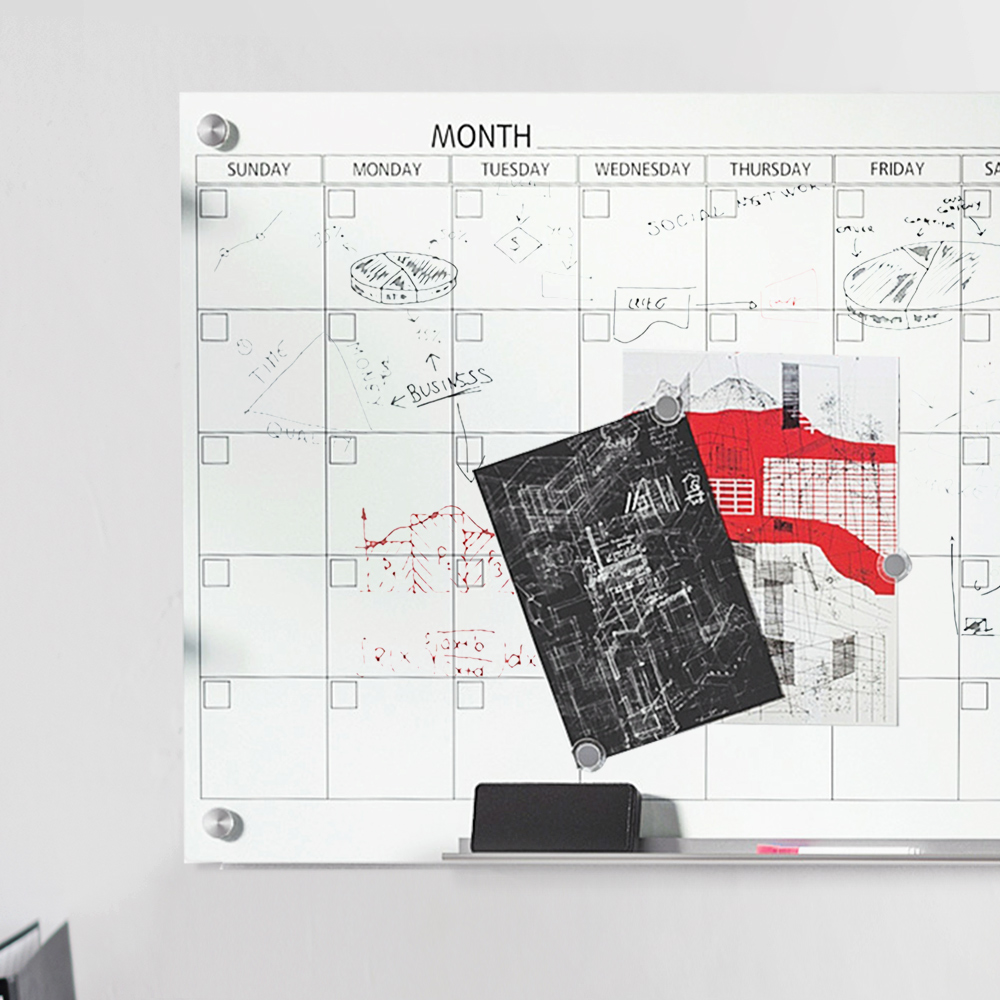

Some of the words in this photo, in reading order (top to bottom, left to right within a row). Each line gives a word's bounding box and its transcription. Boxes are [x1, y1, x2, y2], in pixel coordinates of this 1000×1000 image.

[431, 123, 531, 149] MONTH
[227, 162, 291, 177] SUNDAY
[353, 162, 422, 177] MONDAY
[481, 162, 550, 177] TUESDAY
[595, 162, 691, 177] WEDNESDAY
[730, 162, 811, 177] THURSDAY
[870, 162, 925, 177] FRIDAY
